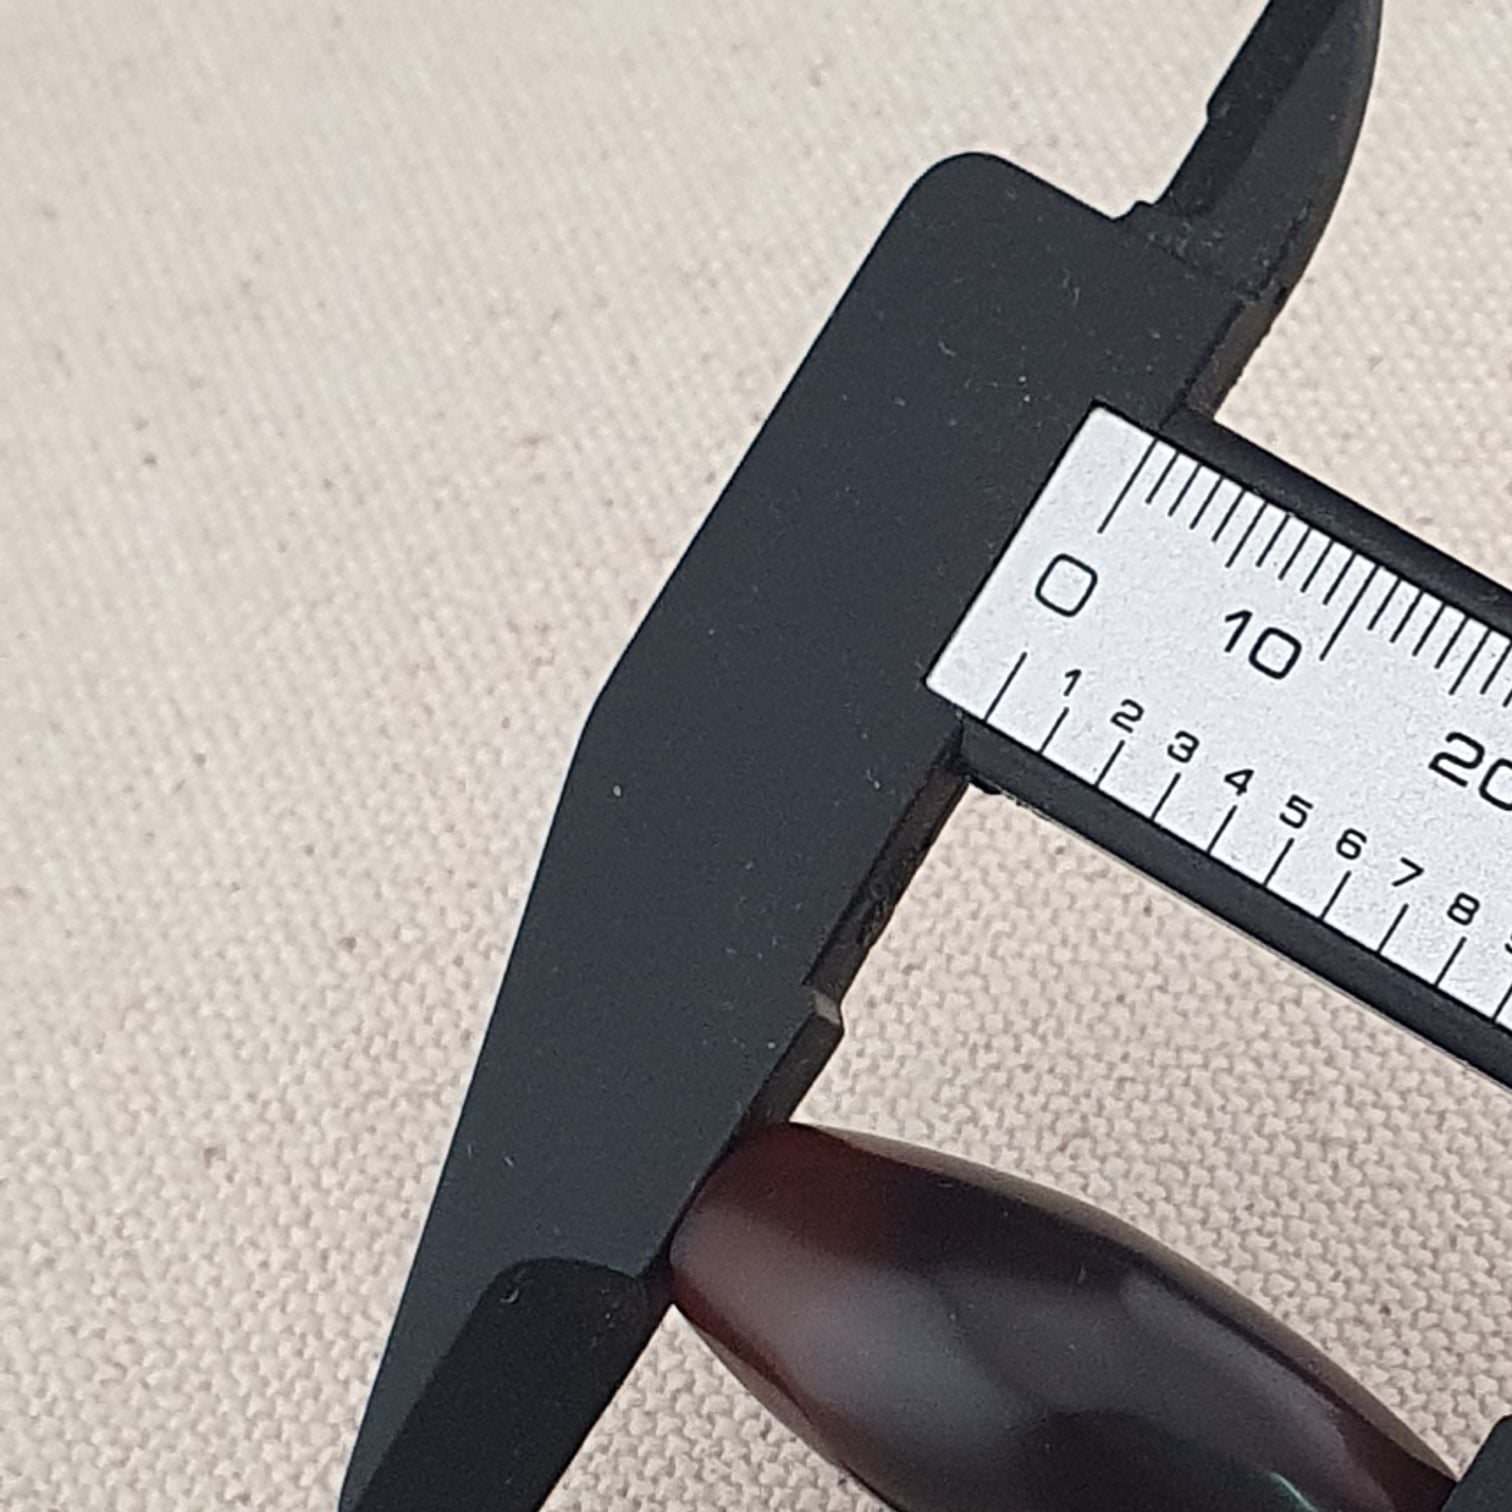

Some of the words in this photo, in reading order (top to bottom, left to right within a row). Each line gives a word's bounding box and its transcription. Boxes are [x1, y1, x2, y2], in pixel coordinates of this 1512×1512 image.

[1034, 553, 1098, 618] 0
[1224, 610, 1302, 680] 10
[1063, 668, 1082, 697] 1
[1110, 699, 1144, 734] 2
[1167, 730, 1200, 764] 3
[1224, 768, 1254, 797] 4
[1279, 794, 1313, 829] 5
[1336, 828, 1367, 860] 6
[1391, 857, 1424, 887] 7
[1446, 892, 1480, 926] 8
